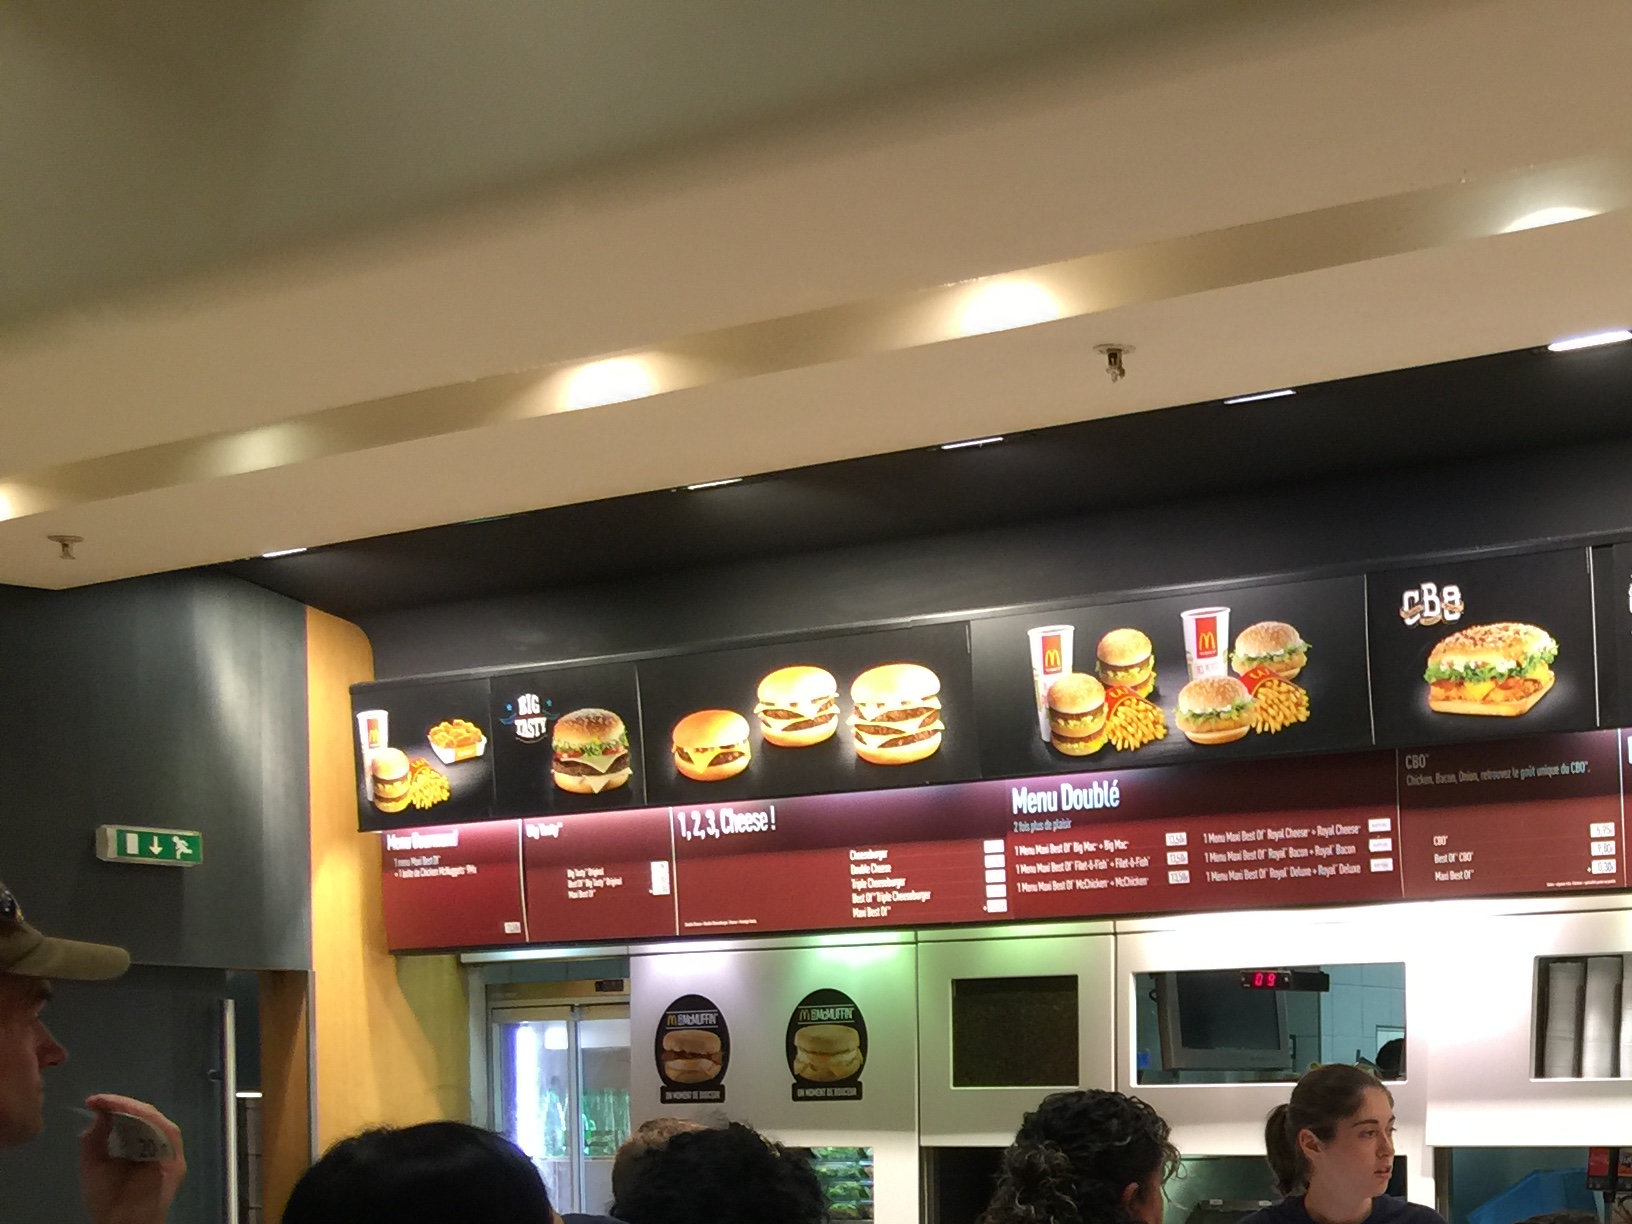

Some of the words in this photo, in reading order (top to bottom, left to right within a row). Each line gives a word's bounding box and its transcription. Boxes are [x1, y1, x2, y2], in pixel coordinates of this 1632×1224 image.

[1402, 582, 1461, 625] CBO
[518, 693, 540, 715] BIG
[514, 717, 547, 738] TASTY
[1481, 769, 1511, 781] retrouvez
[1512, 767, 1519, 779] le
[1537, 764, 1559, 778] unique
[1560, 762, 1570, 775] du
[1012, 786, 1058, 814] Menu
[1060, 779, 1120, 811] Doublé
[720, 808, 768, 834] Cheese
[1030, 820, 1044, 833] plus
[1045, 819, 1052, 831] de
[1241, 831, 1256, 842] Best
[1267, 828, 1284, 842] Royal
[1317, 825, 1335, 838] Royal
[1049, 843, 1063, 855] Best
[1073, 841, 1083, 855] Big
[1104, 840, 1114, 853] Big
[1243, 850, 1257, 861] Best
[1289, 847, 1308, 858] Bacon
[1335, 844, 1356, 855] Bacon
[1434, 852, 1447, 864] Best
[850, 864, 870, 875] Double
[871, 863, 892, 874] Cheese
[1051, 862, 1064, 873] Best
[1244, 869, 1258, 880] Best
[1290, 866, 1311, 877] Deluxe
[1339, 863, 1361, 875] Deluxe
[1435, 871, 1449, 882] Maxi
[1450, 870, 1463, 881] Best
[851, 878, 867, 891] Triple
[868, 877, 906, 890] Cheeseburger
[1052, 880, 1066, 891] Best
[852, 893, 865, 904] Best
[892, 890, 931, 903] Cheeseburger
[867, 906, 880, 918] Best
[1254, 973, 1277, 987] 09
